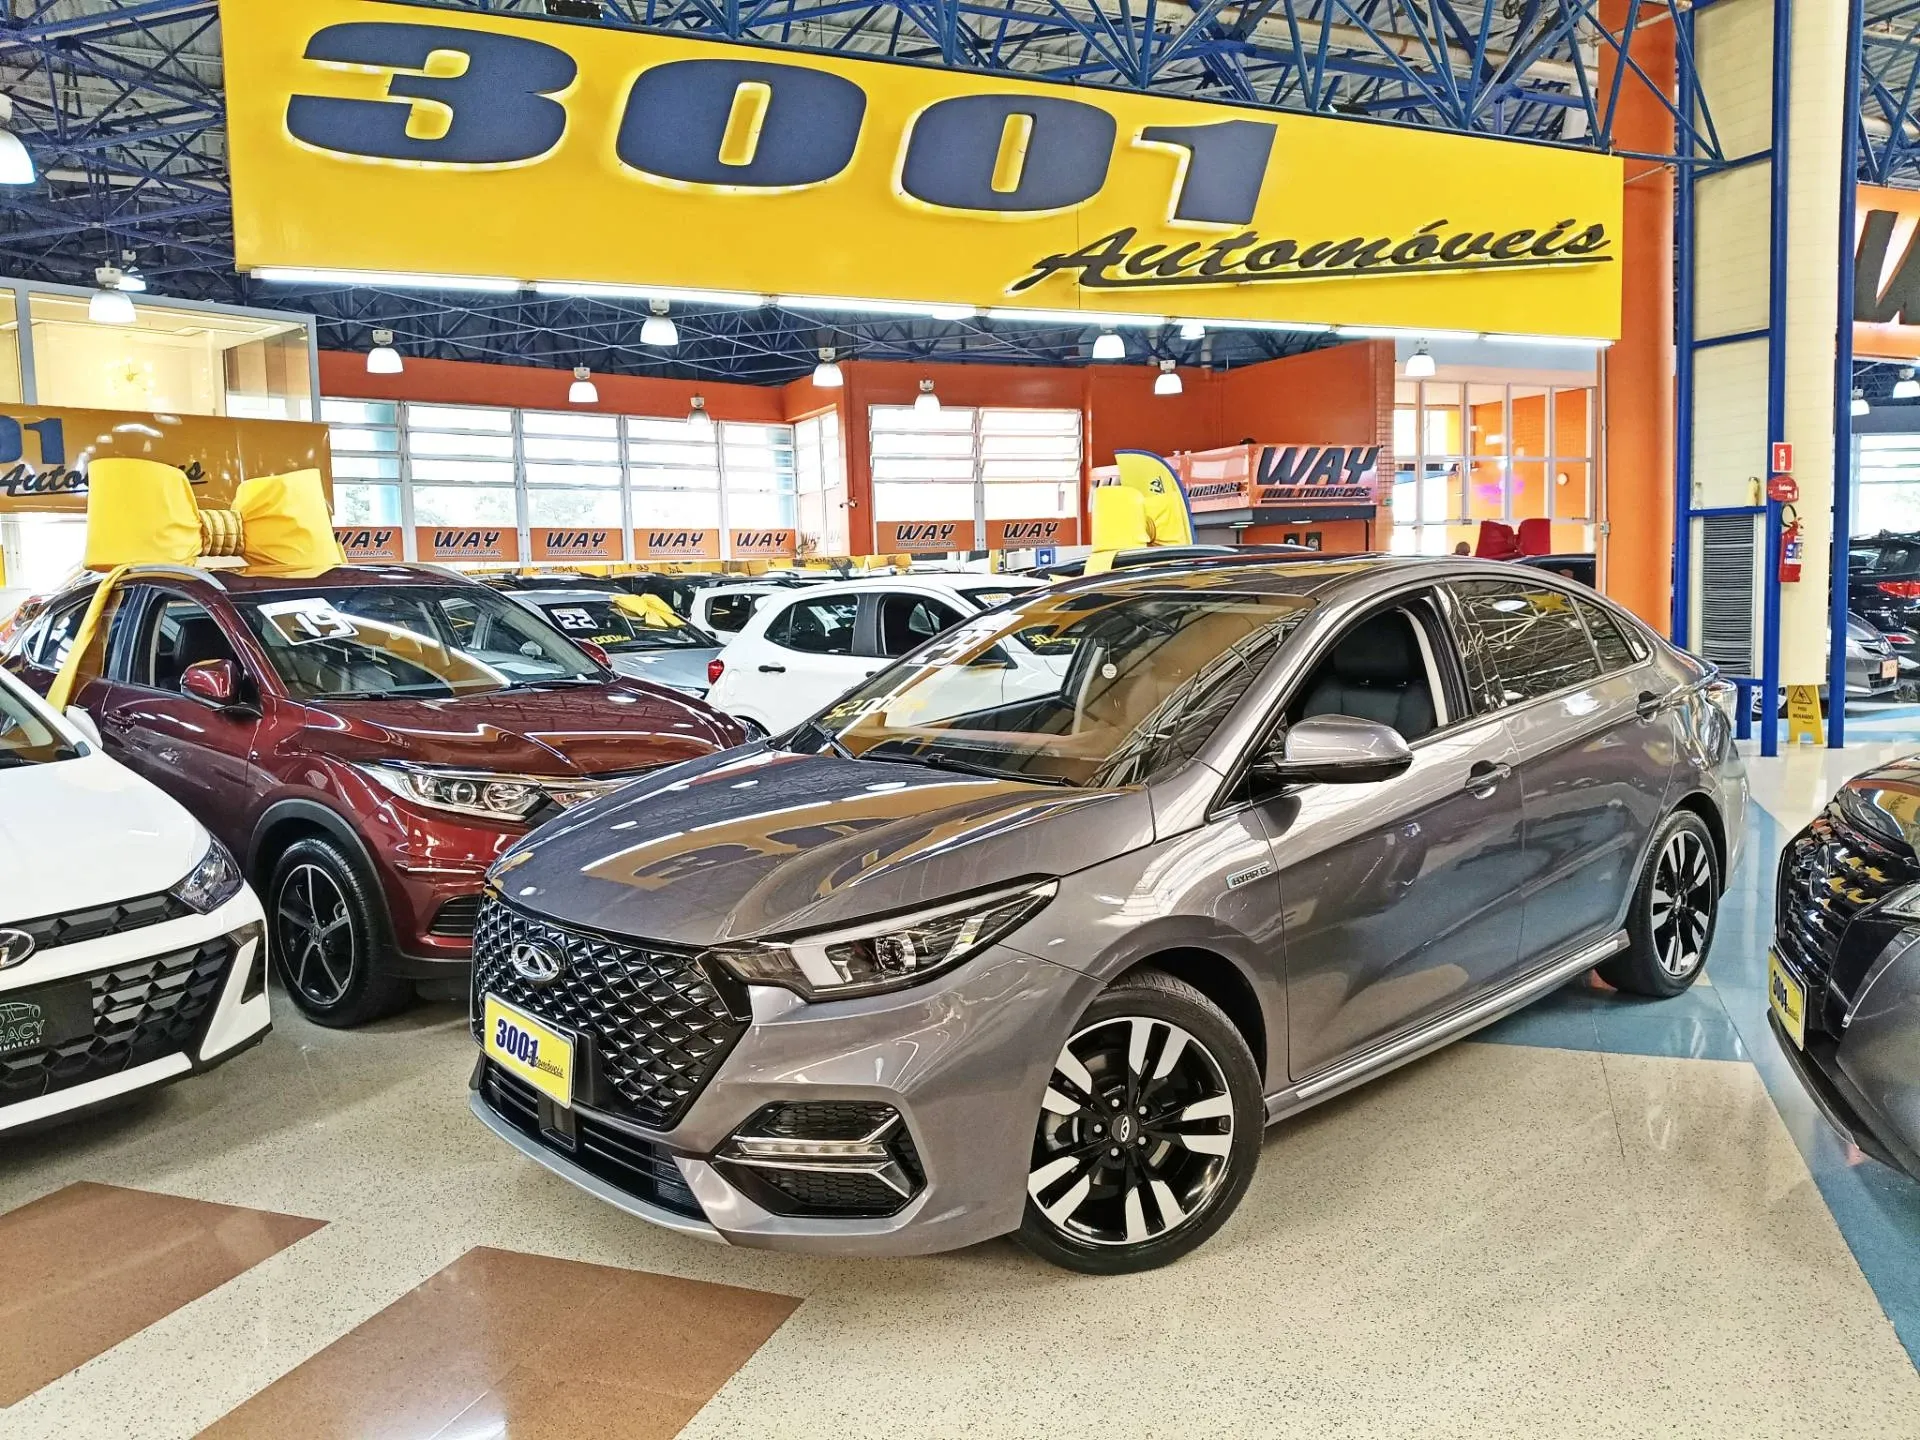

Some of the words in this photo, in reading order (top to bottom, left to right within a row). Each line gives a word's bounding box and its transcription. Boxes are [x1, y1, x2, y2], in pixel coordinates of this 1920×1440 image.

[286, 21, 1278, 228] 3001
[1010, 219, 1613, 293] Automóveis
[1257, 446, 1380, 485] WAY
[1261, 487, 1371, 498] MULTIMARCAS
[896, 524, 956, 540] WAY
[1003, 523, 1059, 538] WAY
[434, 531, 500, 548] WAY
[546, 532, 607, 548] WAY
[649, 533, 704, 547] WAY
[736, 533, 788, 546] WAY
[557, 613, 597, 627] 22
[495, 1017, 539, 1068] 3001
